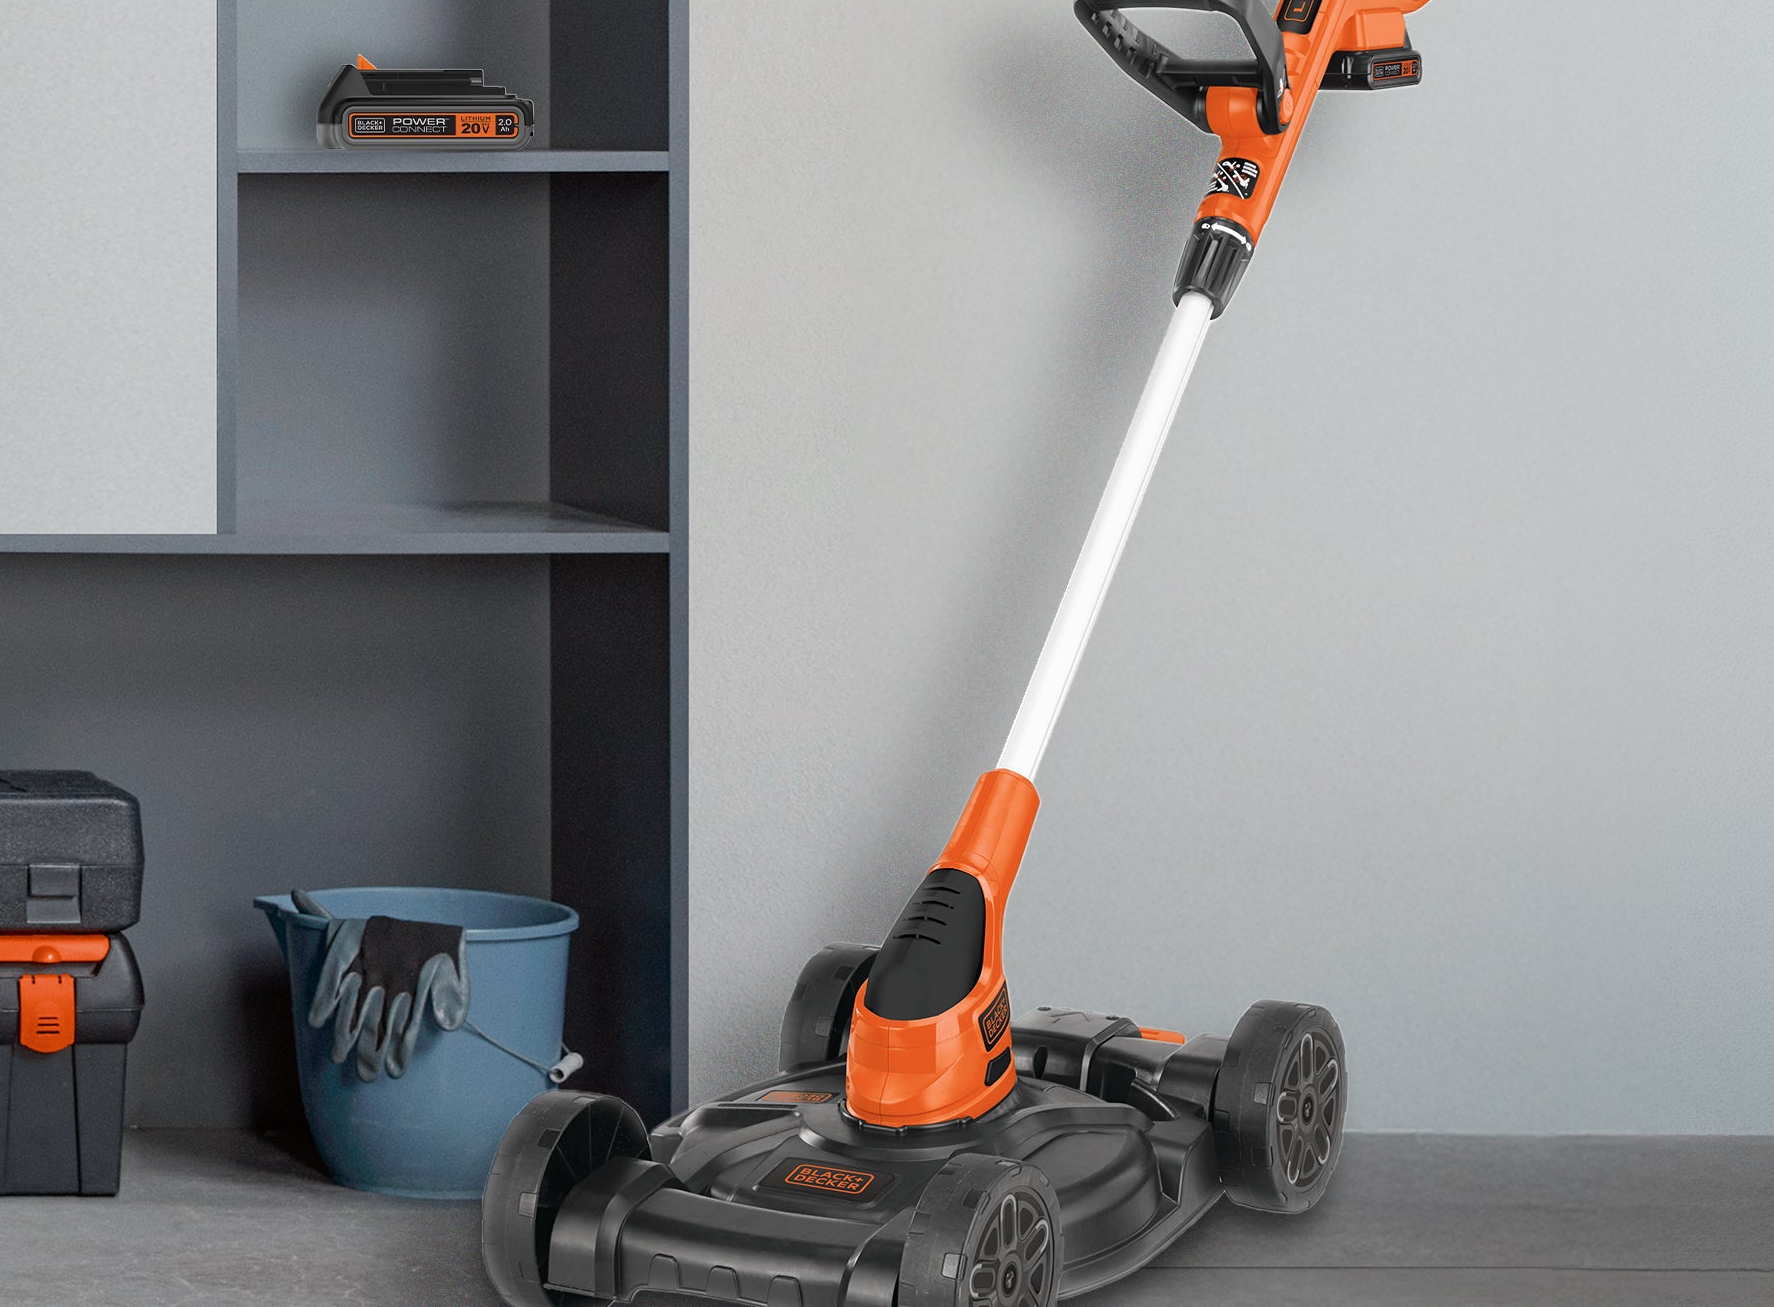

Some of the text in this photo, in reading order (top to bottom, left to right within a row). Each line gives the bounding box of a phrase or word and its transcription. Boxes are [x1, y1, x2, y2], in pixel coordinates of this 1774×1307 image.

[393, 118, 446, 126] POWER
[498, 118, 512, 126] 2.0
[800, 1167, 864, 1182] BLACK+
[794, 1174, 860, 1190] DECKER
